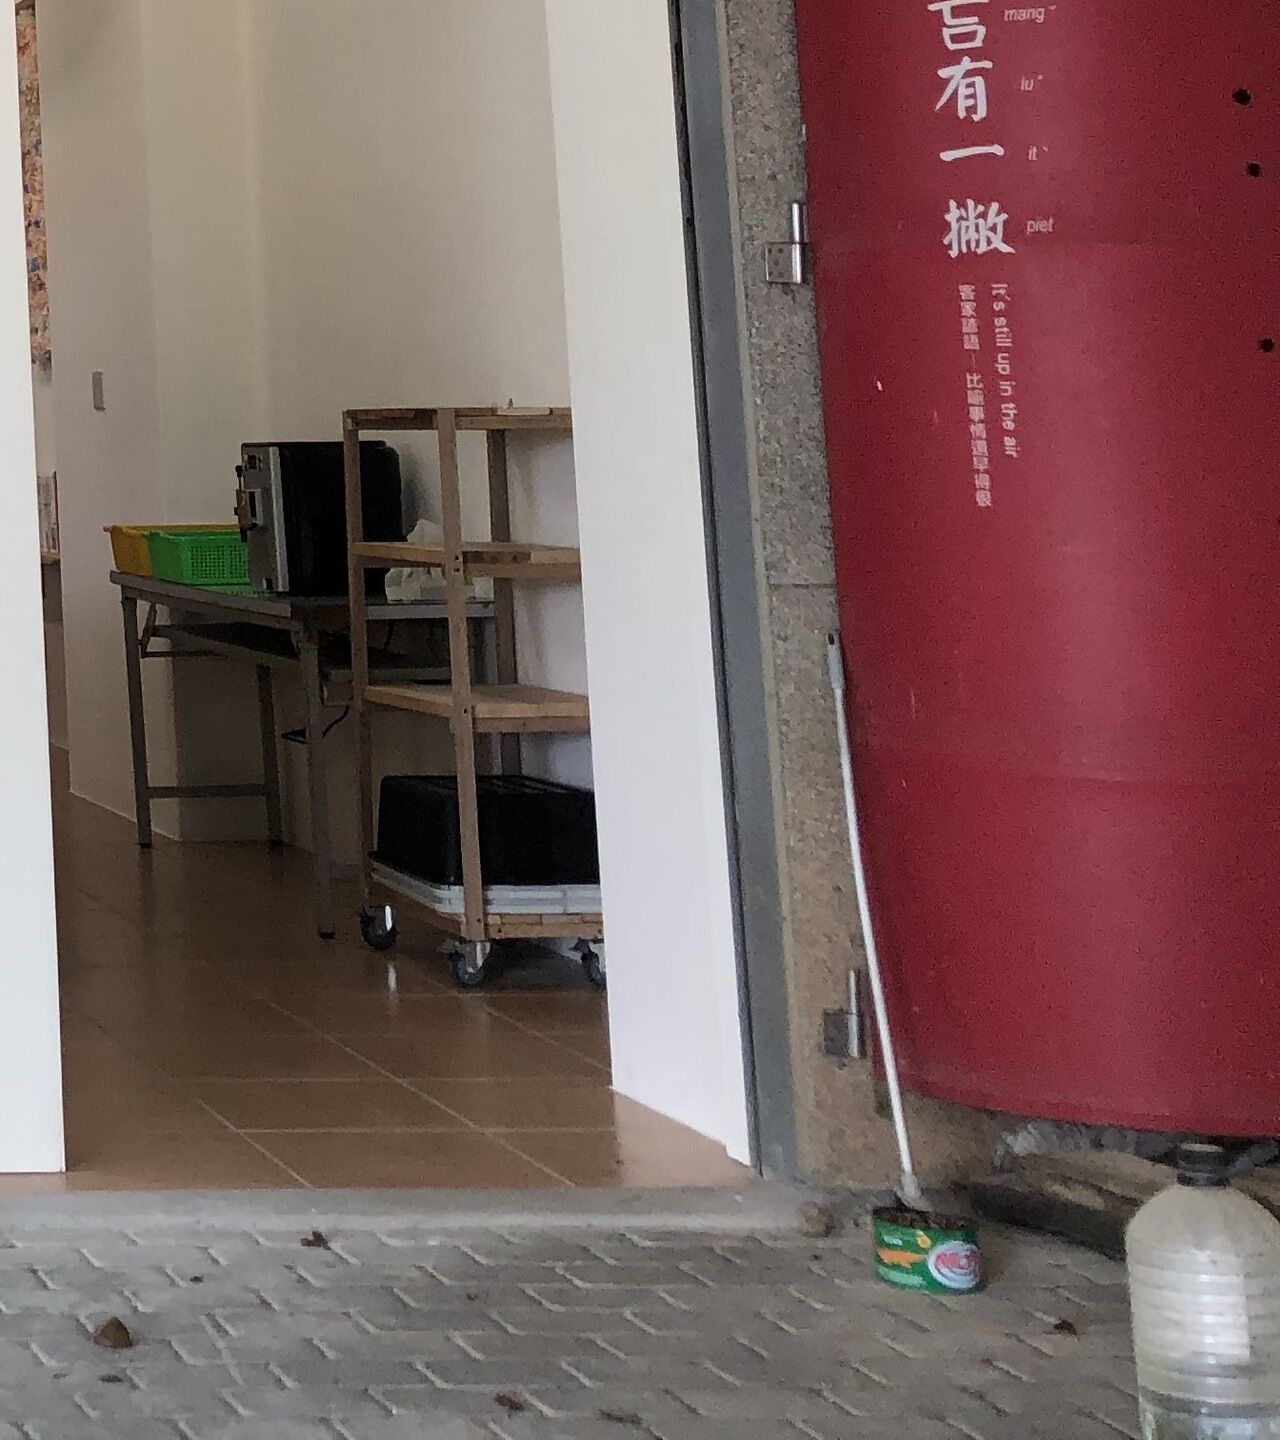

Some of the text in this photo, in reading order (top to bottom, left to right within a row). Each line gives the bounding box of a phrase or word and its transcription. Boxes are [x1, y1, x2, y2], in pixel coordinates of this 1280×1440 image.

[993, 317, 1013, 347] still
[995, 353, 1011, 376] up
[998, 382, 1017, 397] in
[1000, 403, 1019, 431] the
[1004, 436, 1022, 458] air
